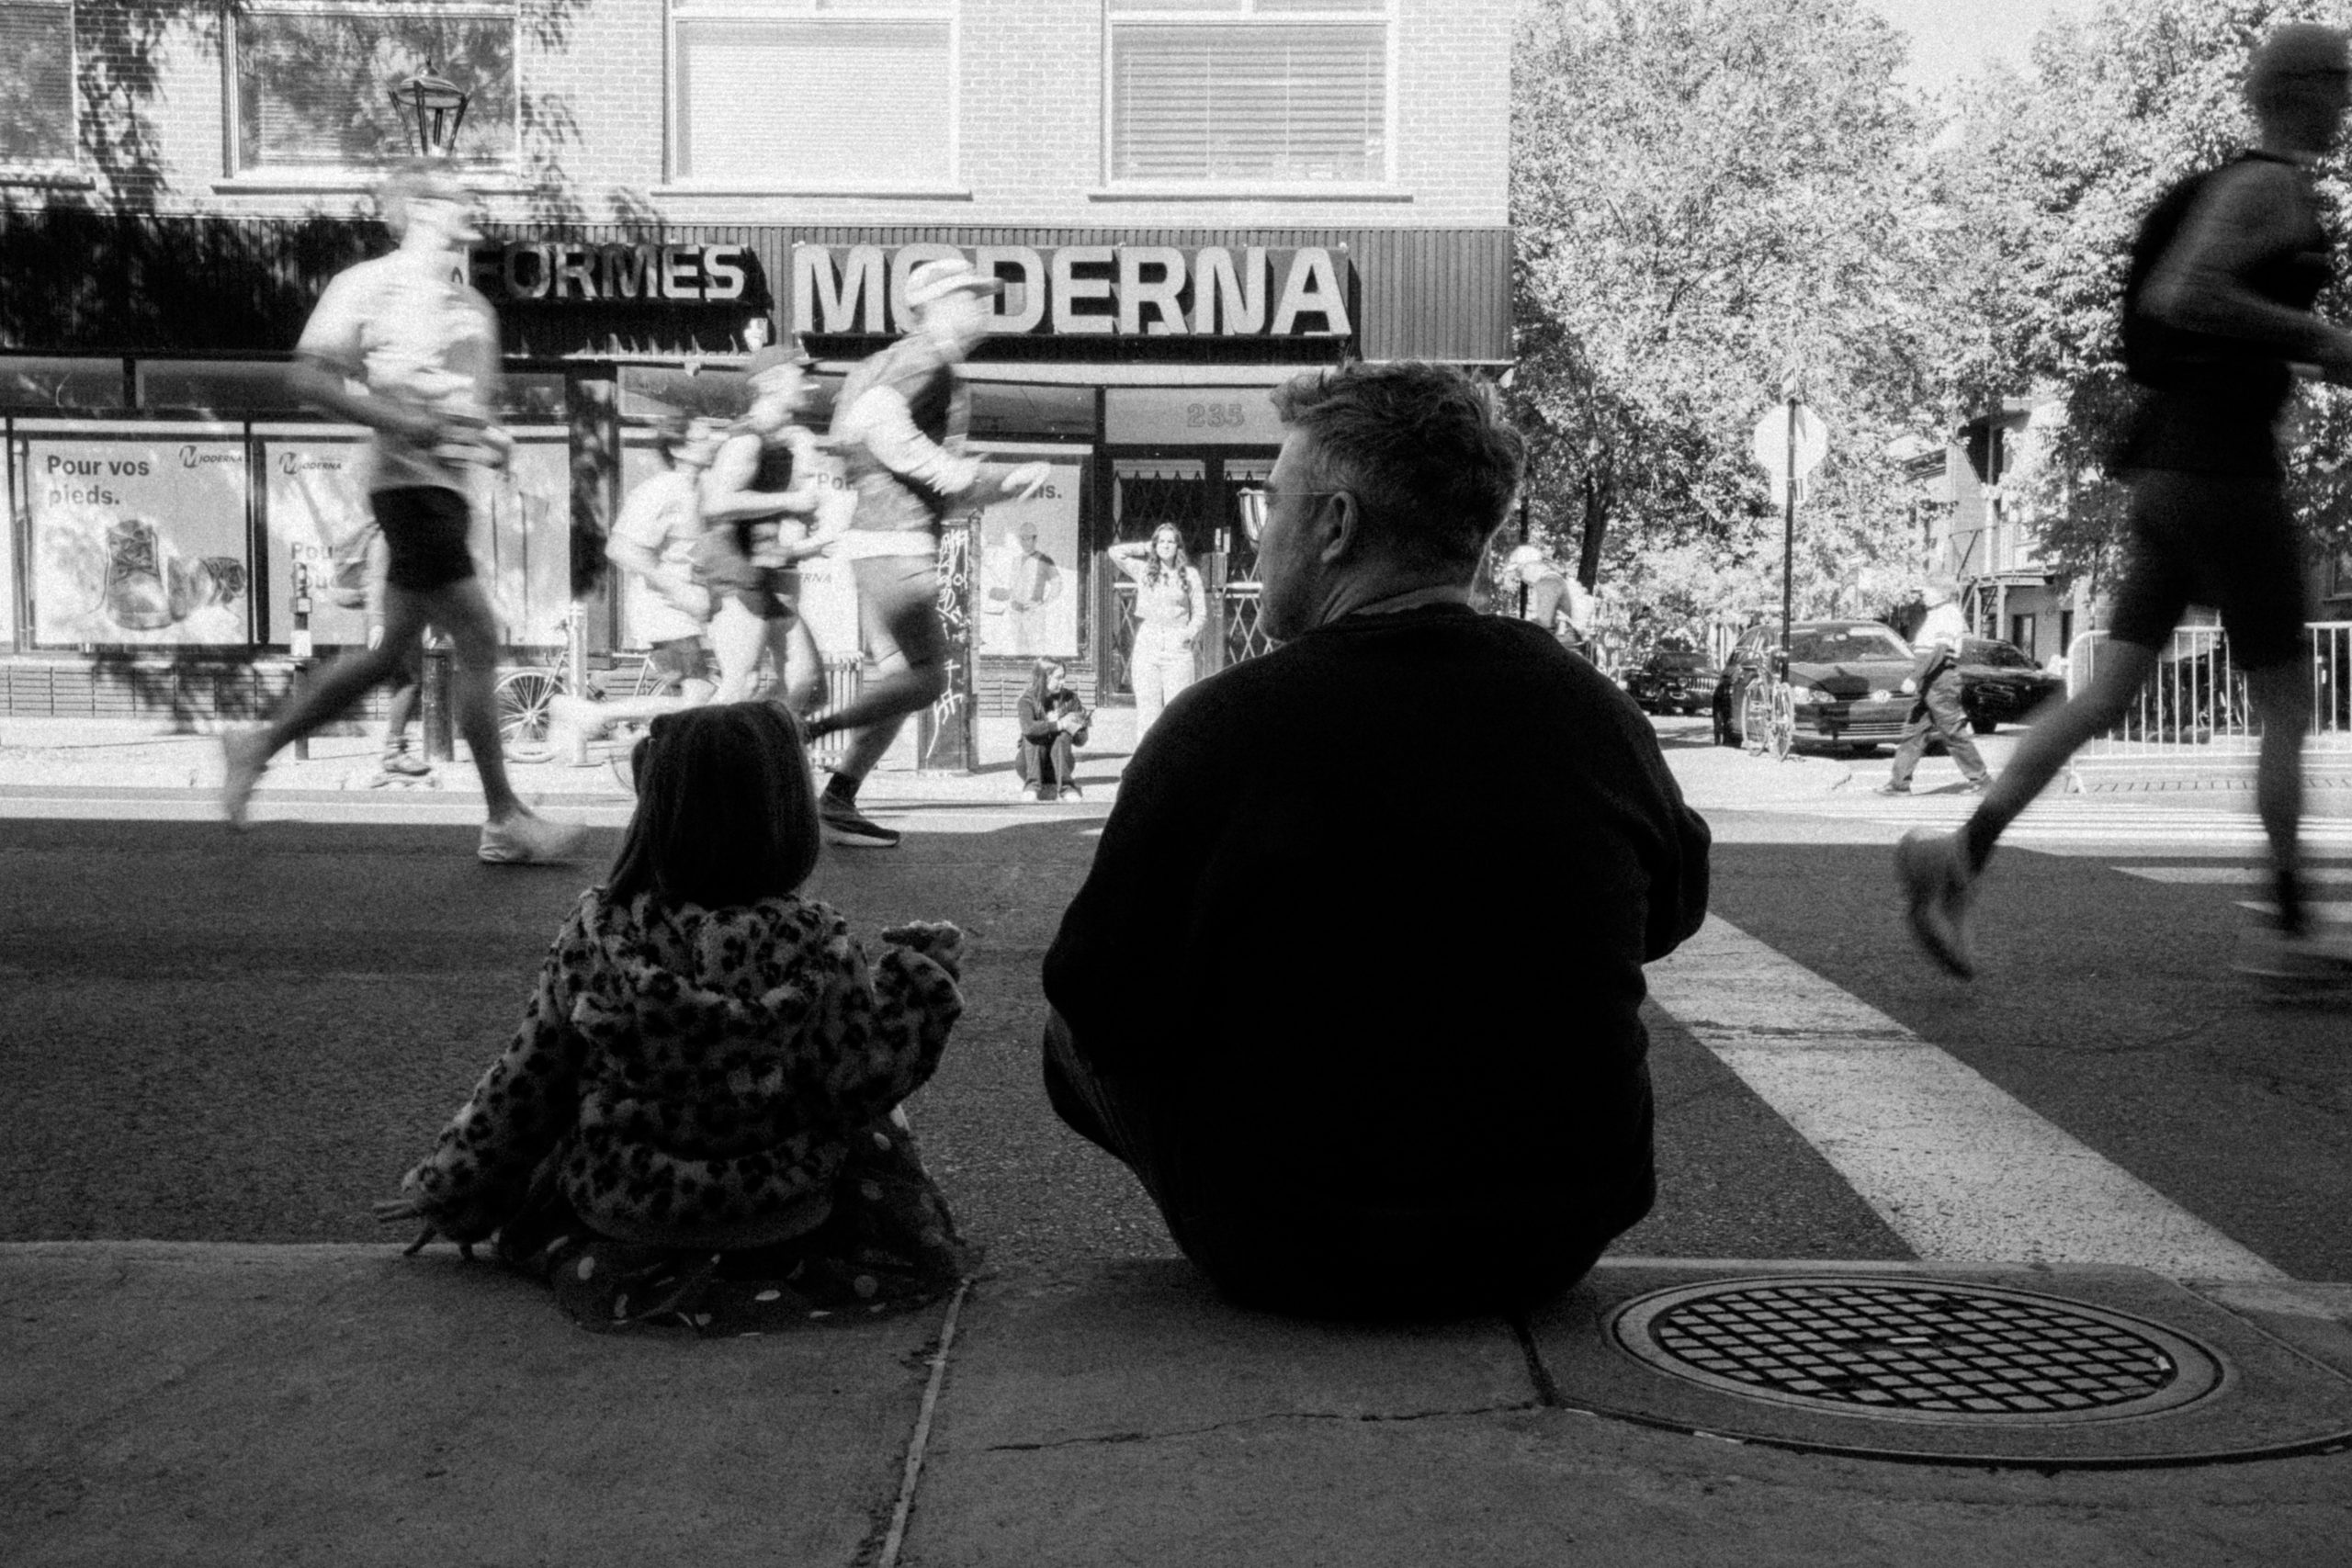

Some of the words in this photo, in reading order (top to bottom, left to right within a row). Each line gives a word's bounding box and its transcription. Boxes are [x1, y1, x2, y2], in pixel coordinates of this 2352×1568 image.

[1186, 402, 1246, 429] 235
[47, 454, 102, 476] Pour
[107, 460, 150, 476] vos
[48, 484, 120, 508] pieds.
